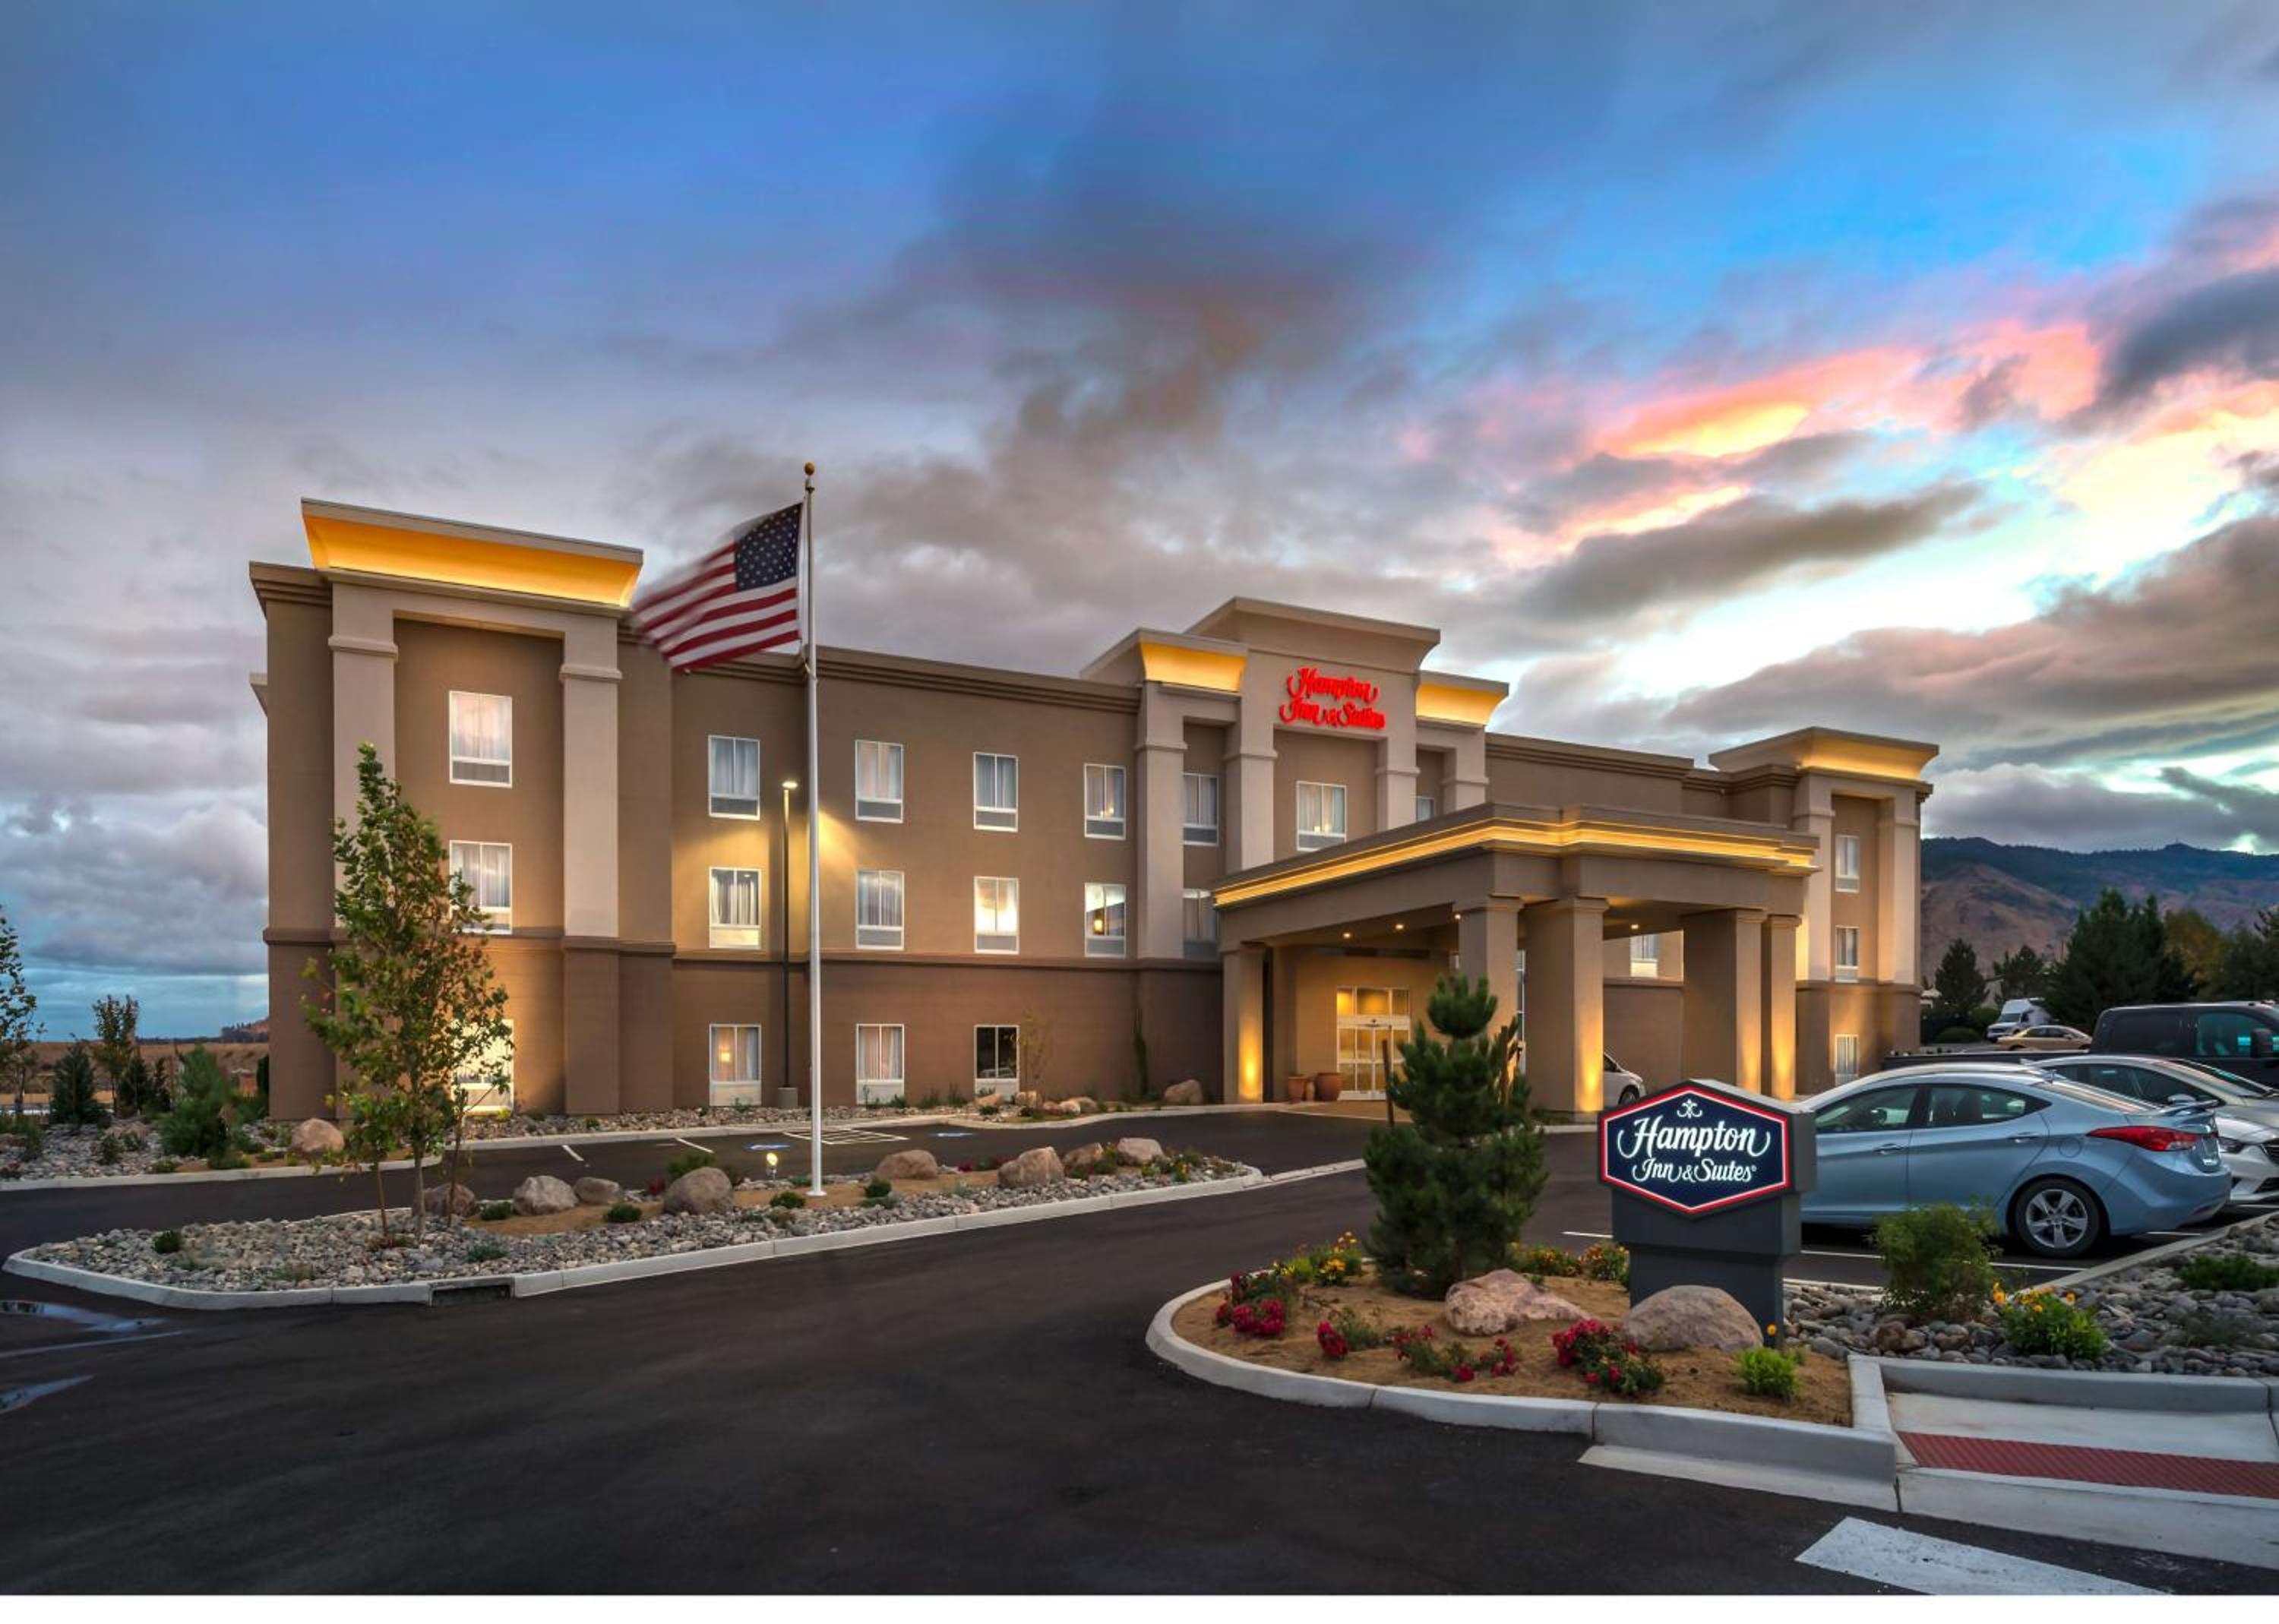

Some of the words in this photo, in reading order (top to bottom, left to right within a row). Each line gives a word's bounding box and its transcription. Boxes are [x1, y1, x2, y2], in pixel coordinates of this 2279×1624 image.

[1287, 668, 1380, 703] Hampton
[1279, 696, 1326, 725] Inn
[1617, 1114, 1771, 1158] Hampton
[1632, 1157, 1683, 1182] Inn
[1683, 1164, 1696, 1183] &
[1694, 1158, 1752, 1182] Suites
